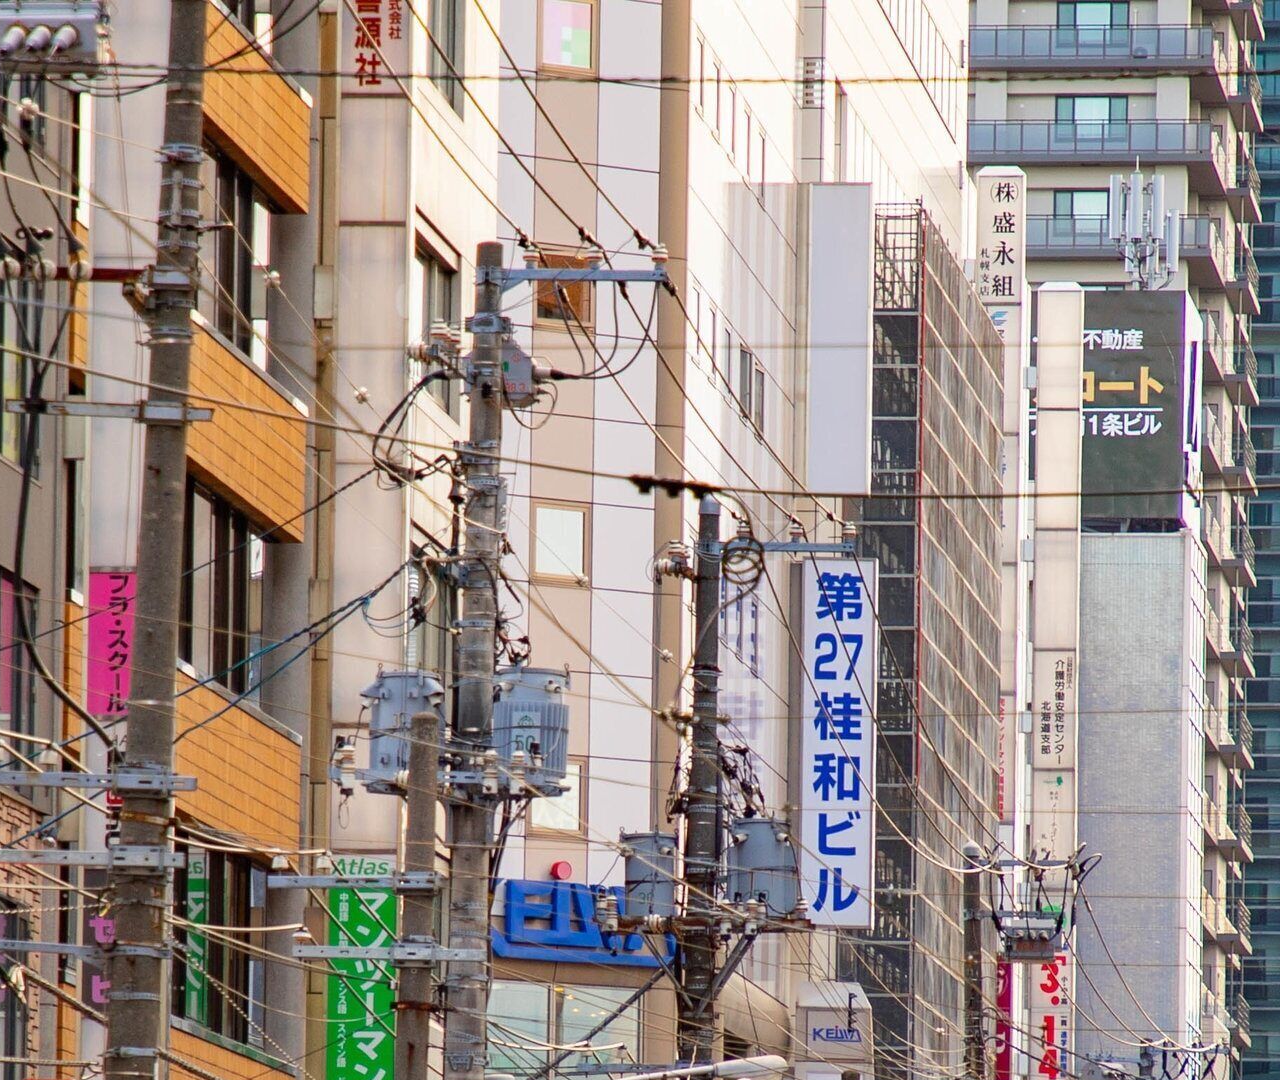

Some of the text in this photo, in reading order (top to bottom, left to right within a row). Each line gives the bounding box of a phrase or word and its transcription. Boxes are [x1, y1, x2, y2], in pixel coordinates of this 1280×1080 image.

[979, 247, 990, 296] 札幌支店
[1084, 330, 1143, 350] 不動産
[813, 571, 864, 914] 第27桂和ビル
[1041, 700, 1051, 755] 北海道支部
[332, 855, 389, 877] Atlas
